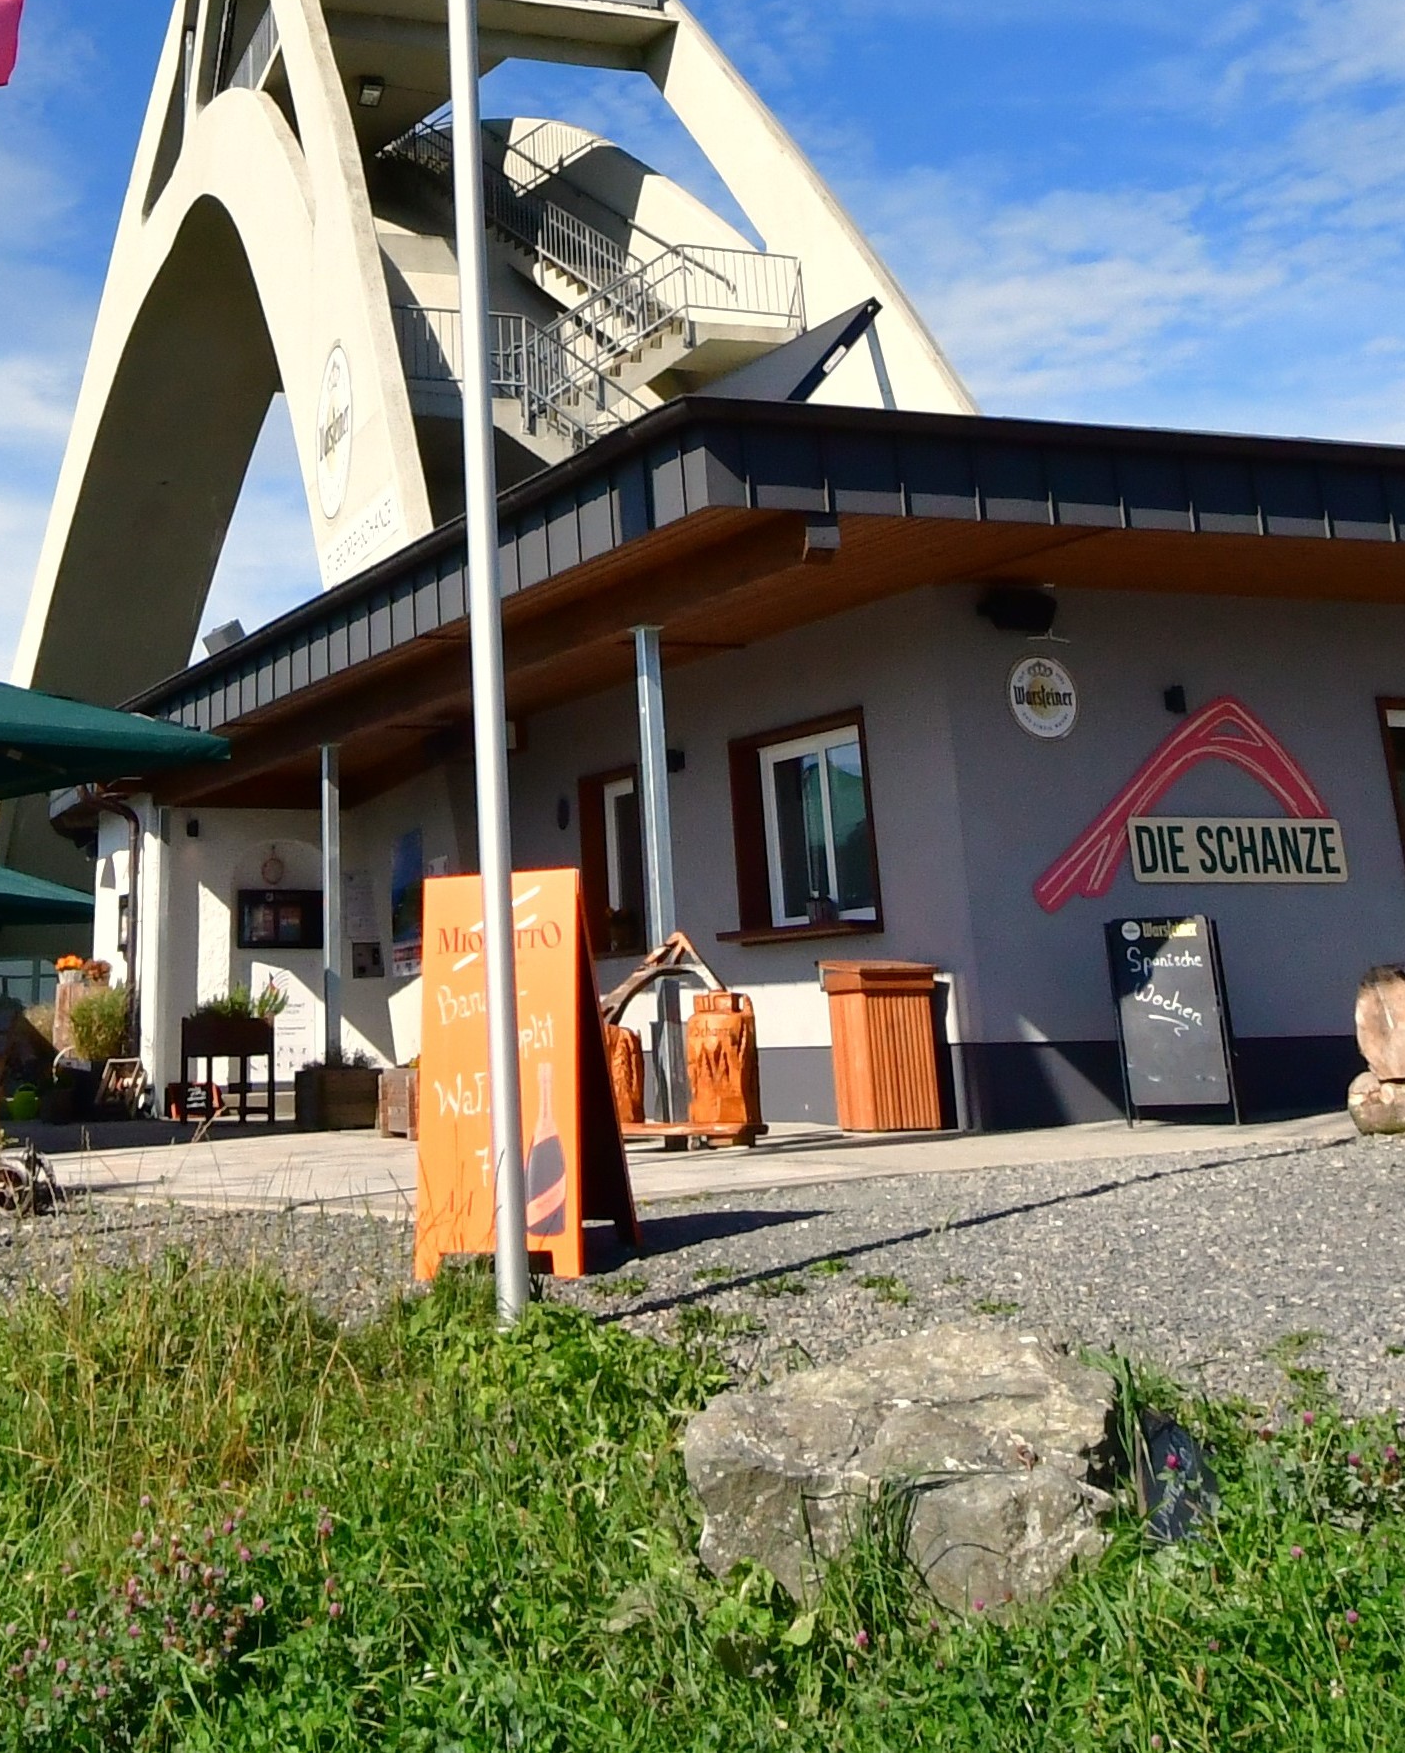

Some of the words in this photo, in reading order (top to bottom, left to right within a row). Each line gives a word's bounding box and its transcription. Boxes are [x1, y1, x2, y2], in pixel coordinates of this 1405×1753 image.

[1013, 684, 1073, 708] Warsteiner
[1135, 825, 1190, 874] DIE
[1196, 825, 1341, 875] SCHANZE
[437, 920, 562, 955] MIOTTO
[1126, 946, 1203, 977] Spanische
[1134, 983, 1203, 1027] Wochen
